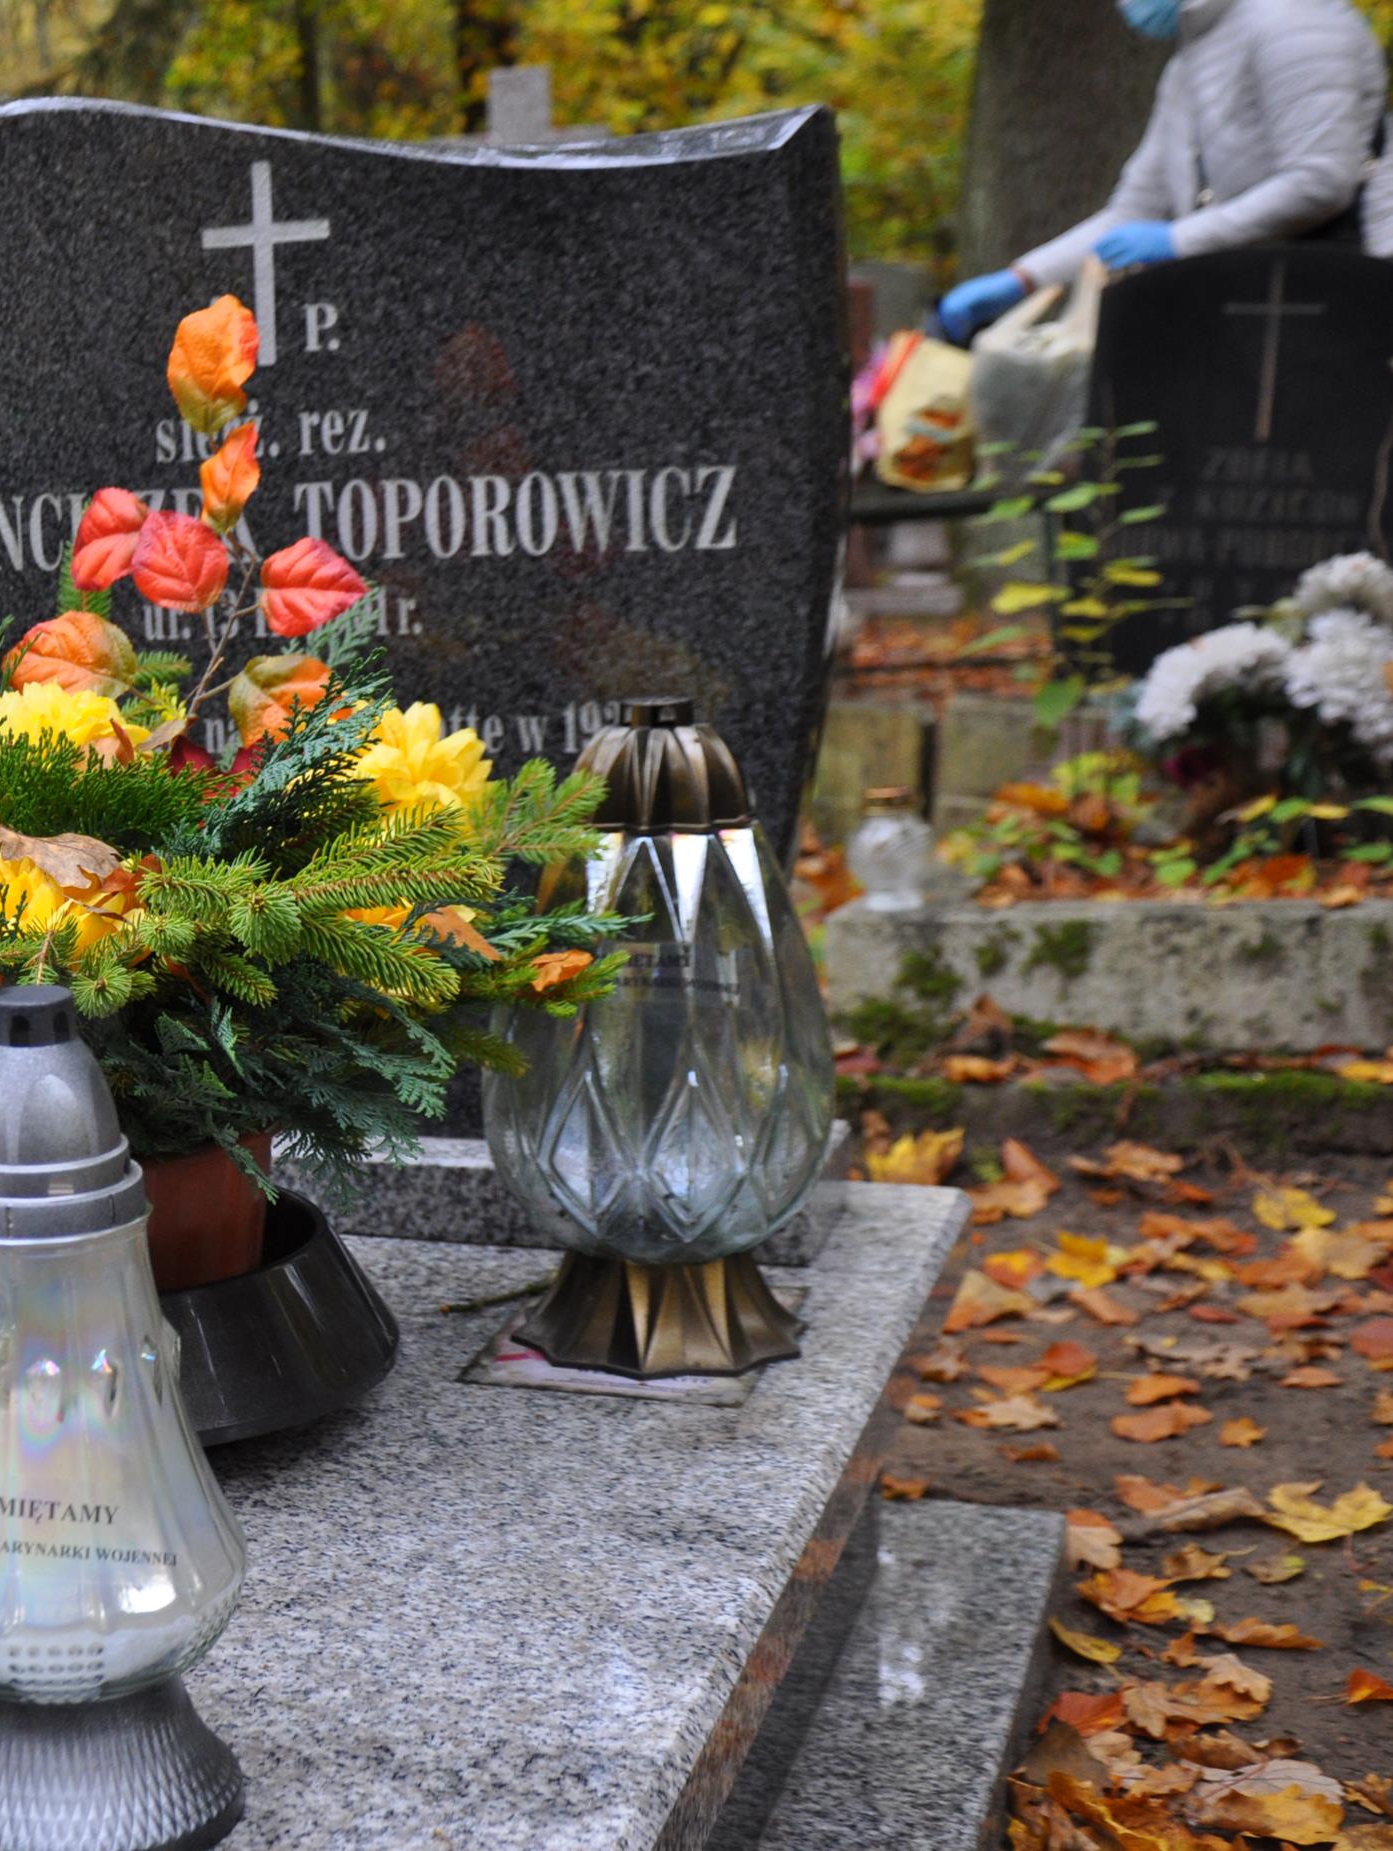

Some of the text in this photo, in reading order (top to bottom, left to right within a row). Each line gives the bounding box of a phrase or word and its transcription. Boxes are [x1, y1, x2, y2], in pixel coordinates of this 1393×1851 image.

[304, 302, 341, 352] P.
[298, 409, 387, 456] rez.
[294, 466, 738, 562] TOPOROWICZ
[516, 715, 549, 752] w
[95, 1547, 178, 1567] WOJENNEJ
